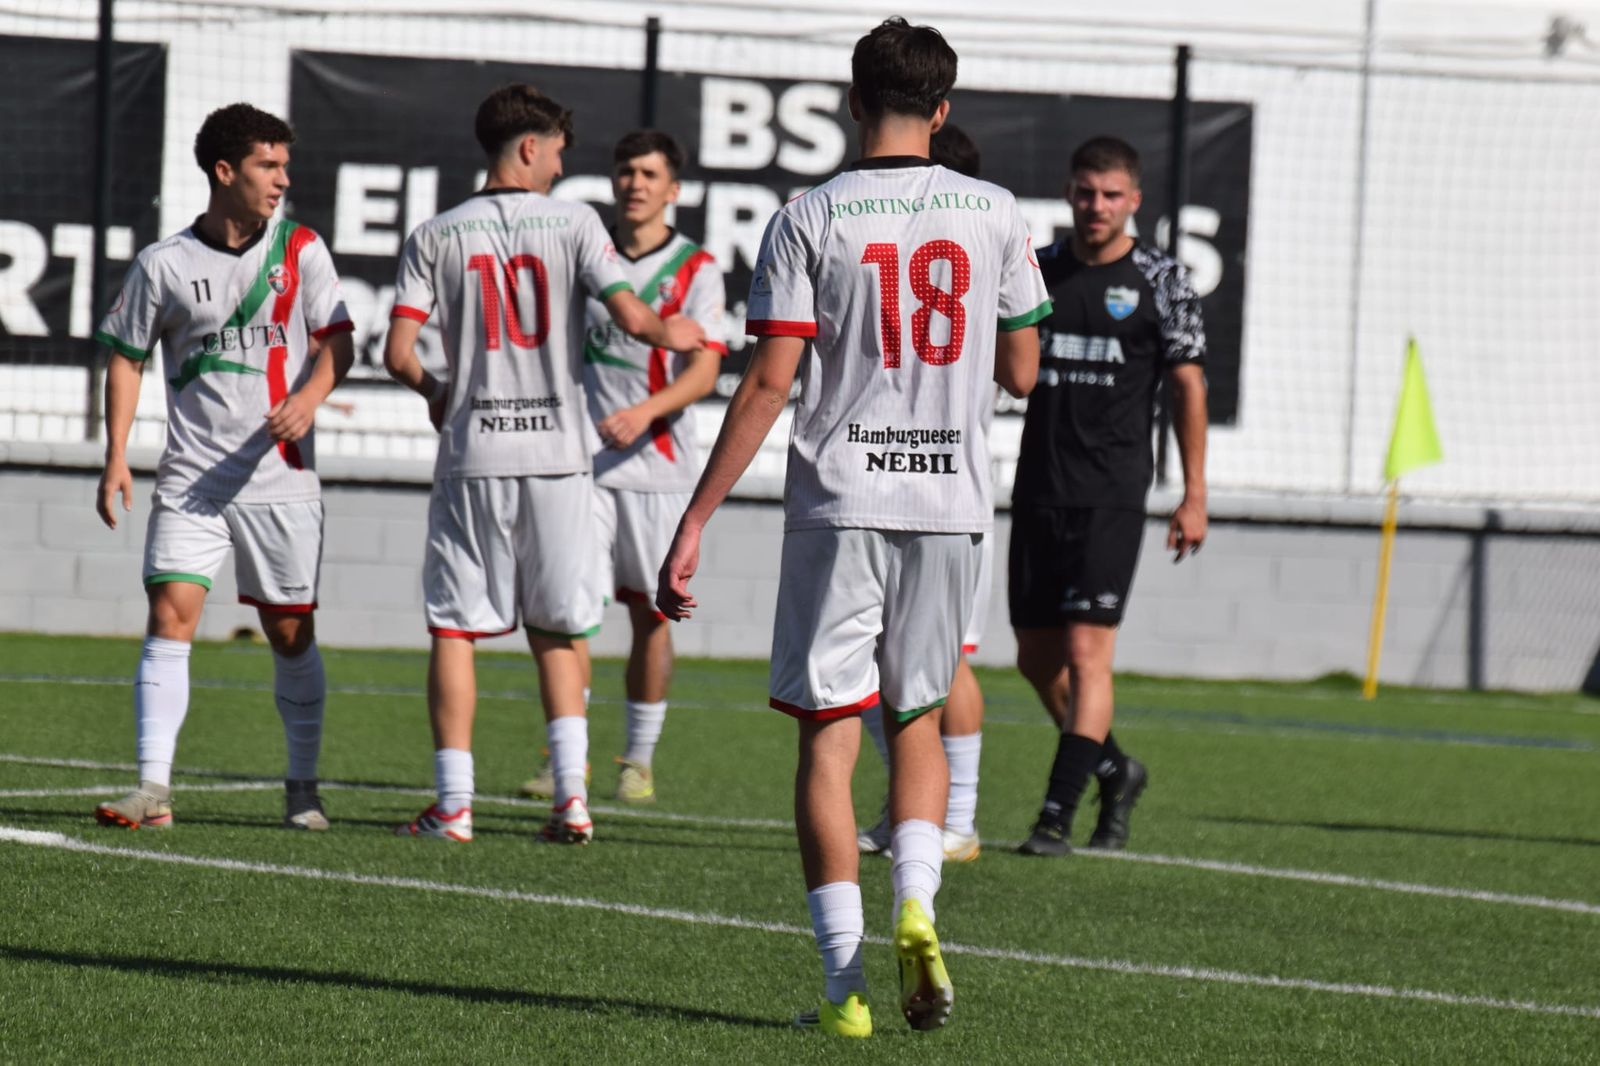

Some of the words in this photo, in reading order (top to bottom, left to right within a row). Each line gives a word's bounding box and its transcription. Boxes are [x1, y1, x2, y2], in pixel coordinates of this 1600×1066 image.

[700, 77, 846, 174] BS
[828, 197, 925, 220] SPORTING
[930, 192, 991, 212] ATLCO
[190, 278, 212, 303] 11
[467, 253, 550, 351] 10
[860, 239, 971, 368] 18
[202, 323, 288, 353] CEUTA
[479, 415, 554, 433] NEBIL
[865, 452, 958, 474] NEBIL
